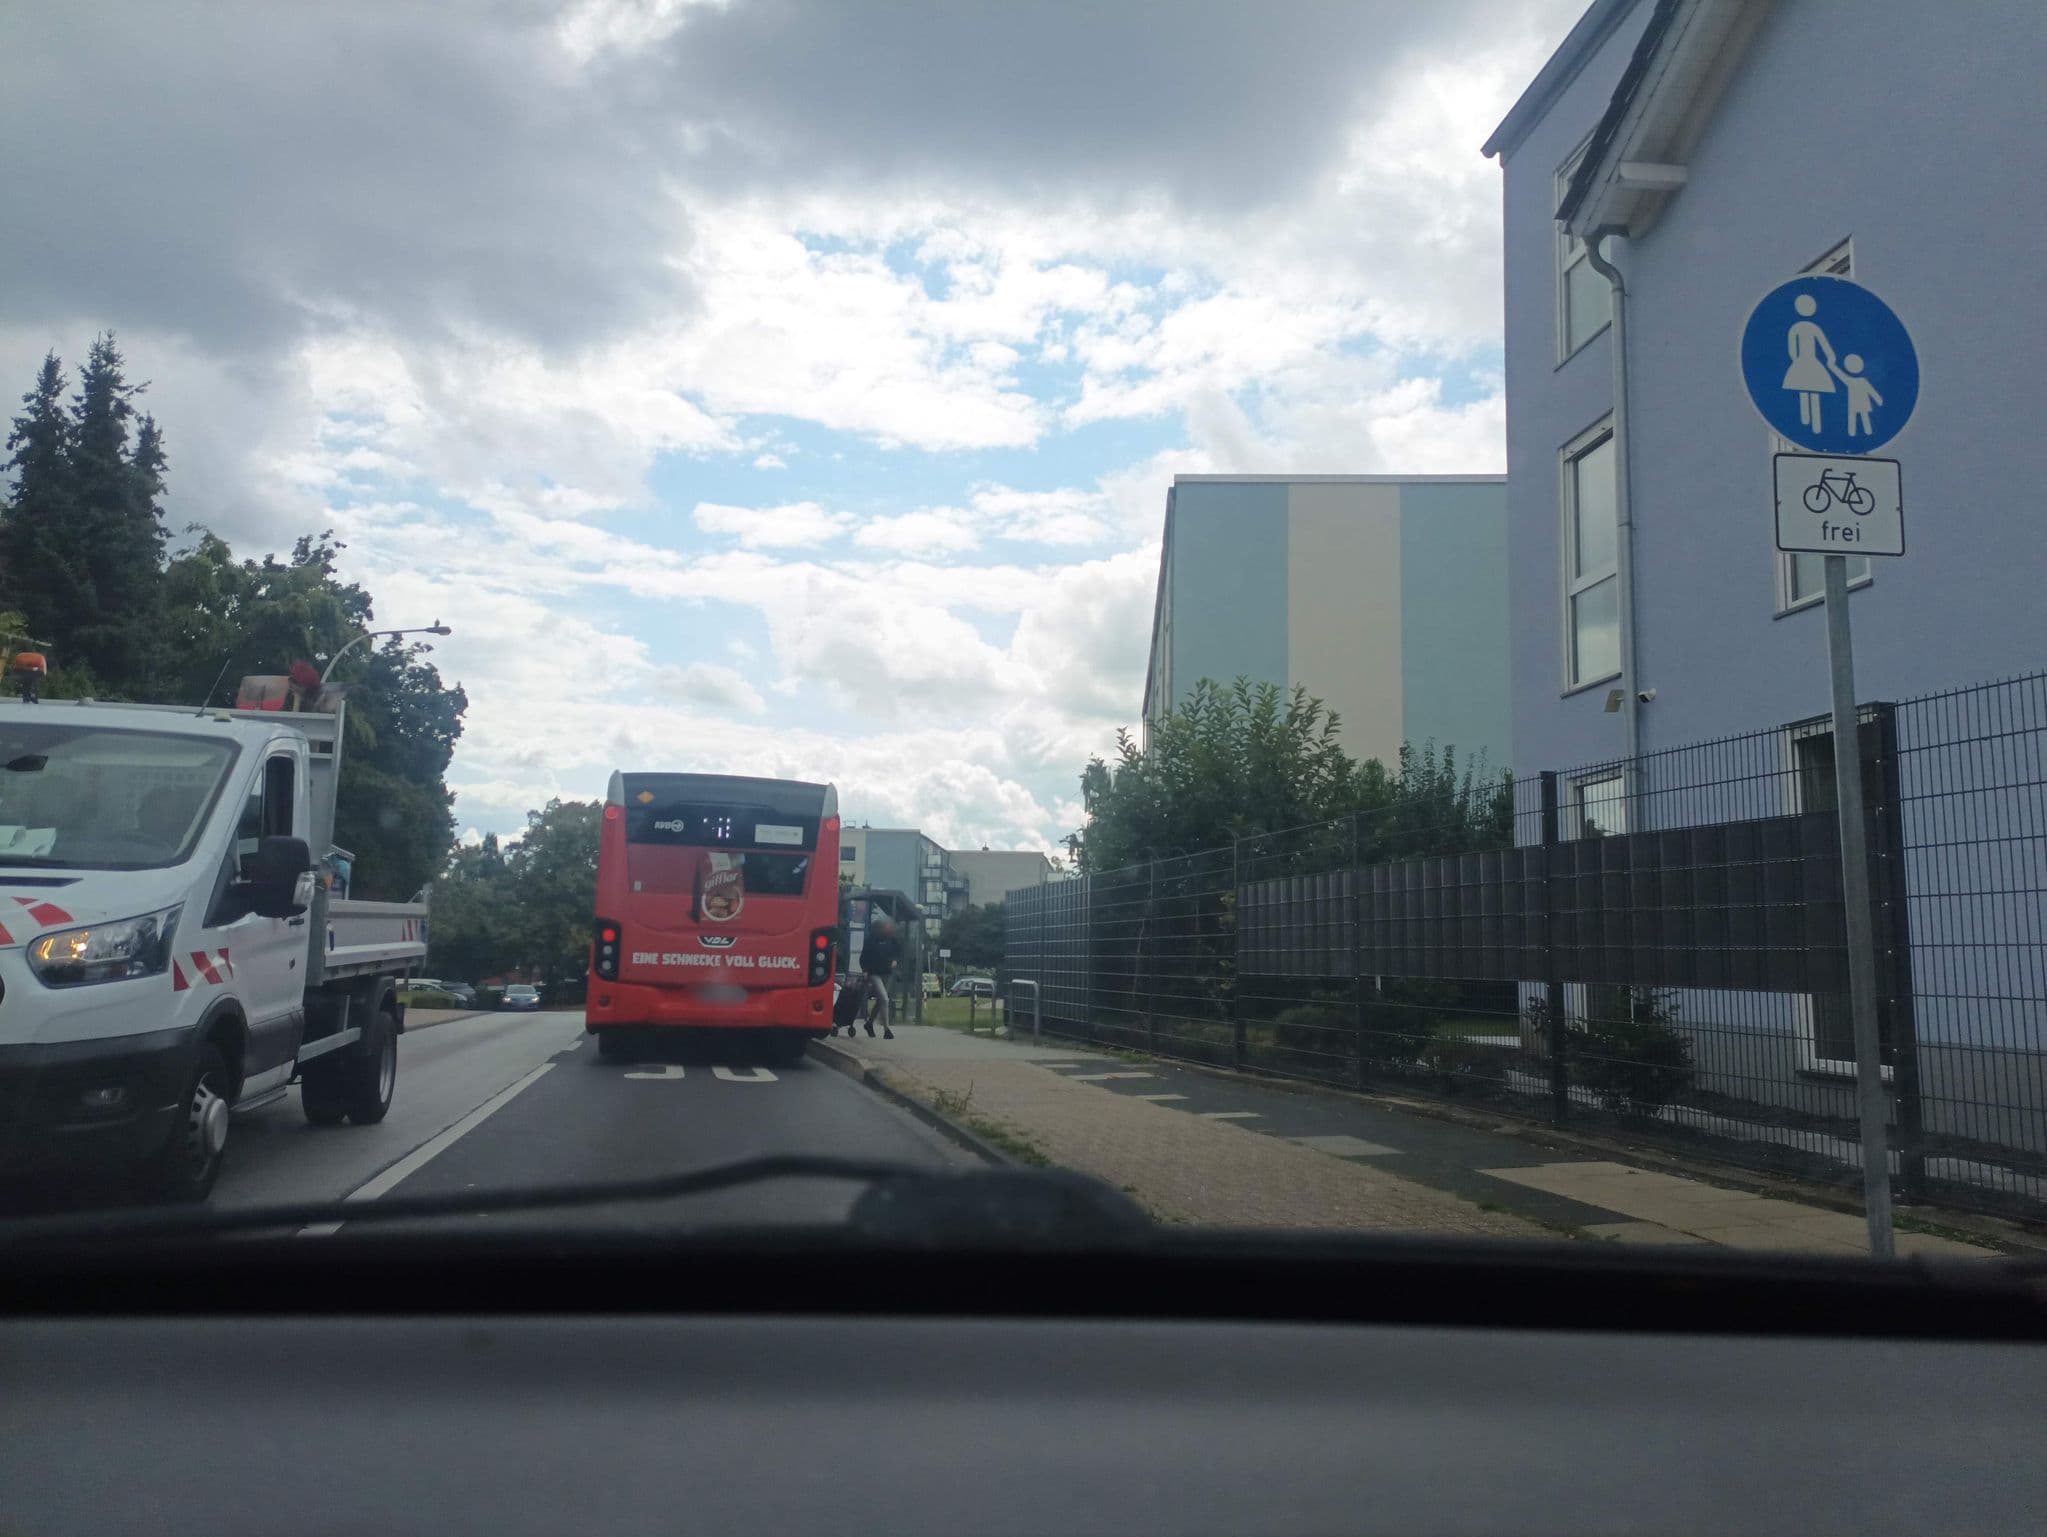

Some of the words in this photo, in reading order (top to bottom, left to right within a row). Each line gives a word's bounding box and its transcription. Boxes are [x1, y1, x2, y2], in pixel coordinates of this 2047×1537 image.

[1821, 520, 1861, 542] frei
[632, 952, 659, 965] EINE
[662, 953, 722, 967] SCHNECKE
[725, 955, 755, 968] VOLL
